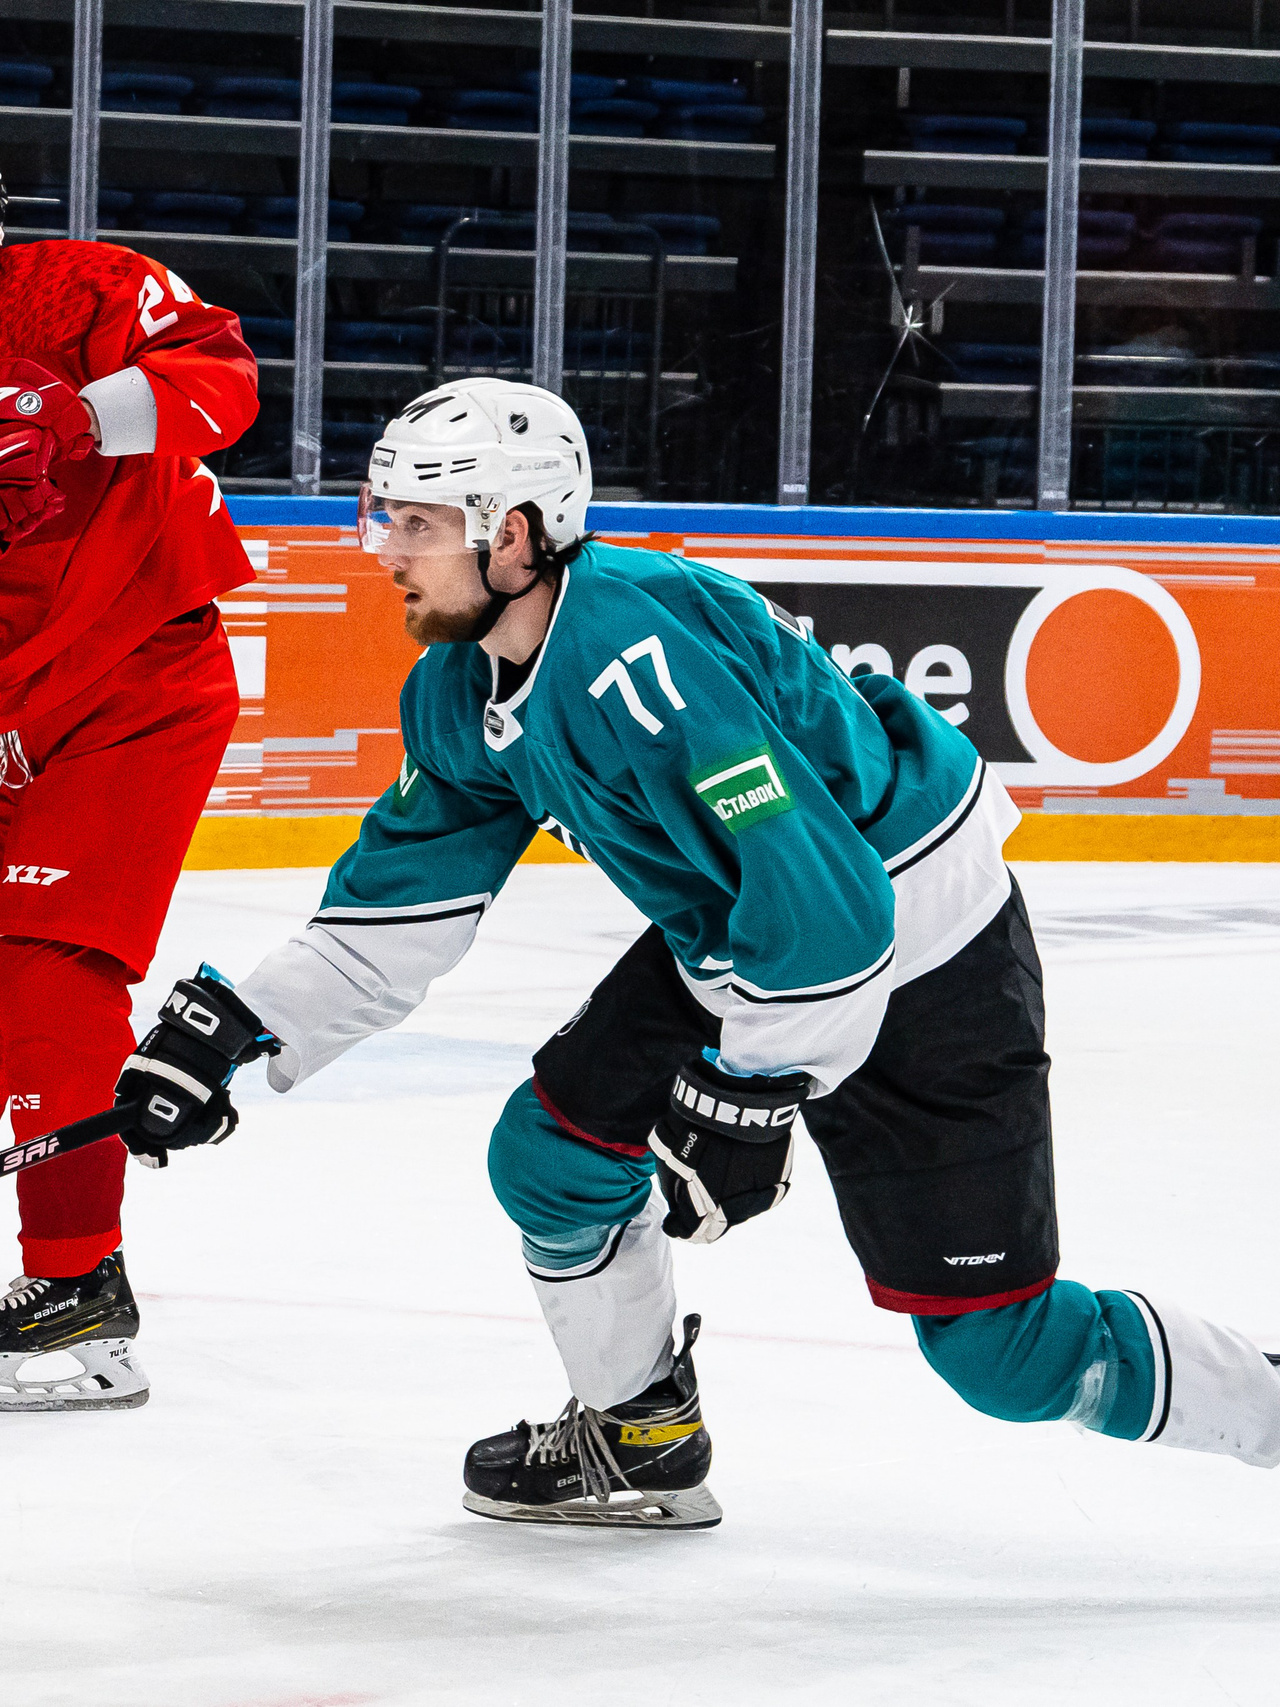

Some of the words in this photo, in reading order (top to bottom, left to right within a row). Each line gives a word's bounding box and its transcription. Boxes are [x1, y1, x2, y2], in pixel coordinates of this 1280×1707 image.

[588, 634, 687, 736] 77
[2, 864, 71, 886] X17
[165, 990, 221, 1036] RO
[680, 1132, 698, 1159] goat
[943, 1252, 1006, 1265] VITOKIN
[33, 1297, 78, 1320] BAUER
[556, 1474, 584, 1488] BAU
